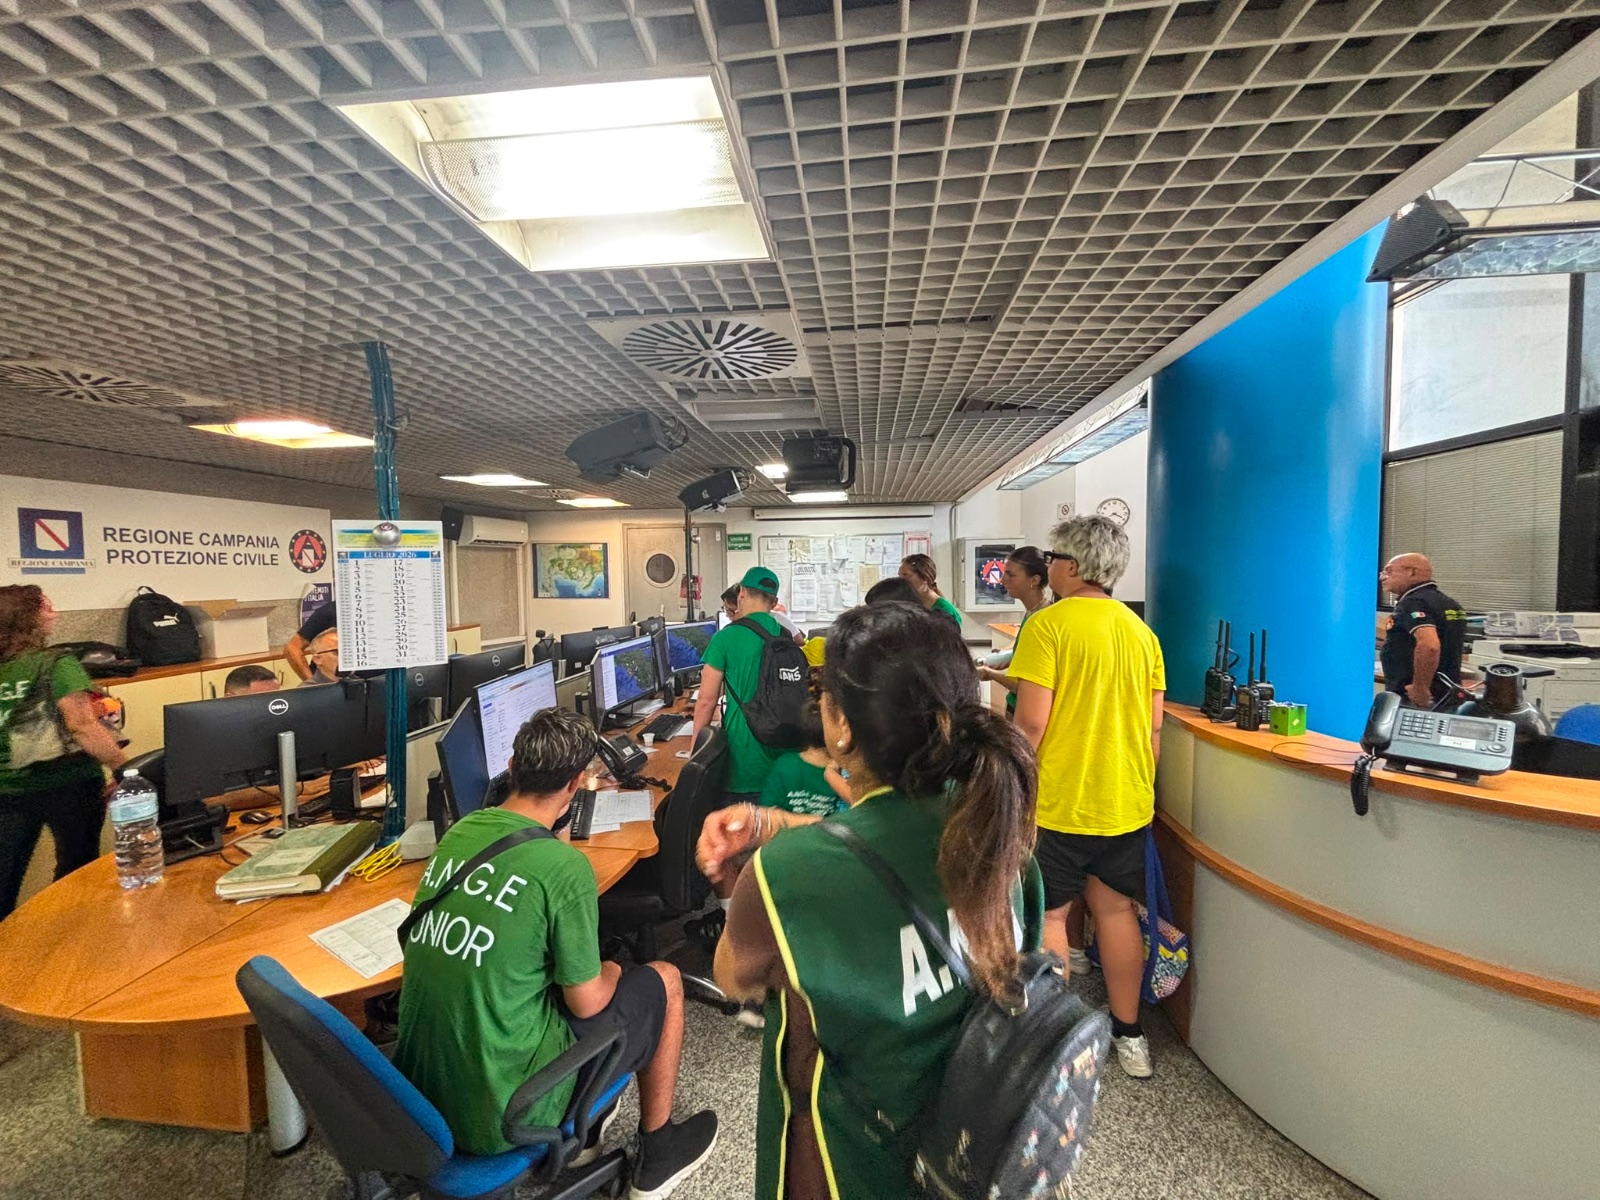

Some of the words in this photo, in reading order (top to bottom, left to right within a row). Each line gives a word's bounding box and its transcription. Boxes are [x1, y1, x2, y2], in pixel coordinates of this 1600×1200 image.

[103, 527, 194, 546] REGIONE
[199, 532, 280, 549] CAMPANIA
[106, 549, 228, 565] PROTEZIONE
[232, 552, 279, 566] CIVILE
[410, 909, 495, 968] UNIOR
